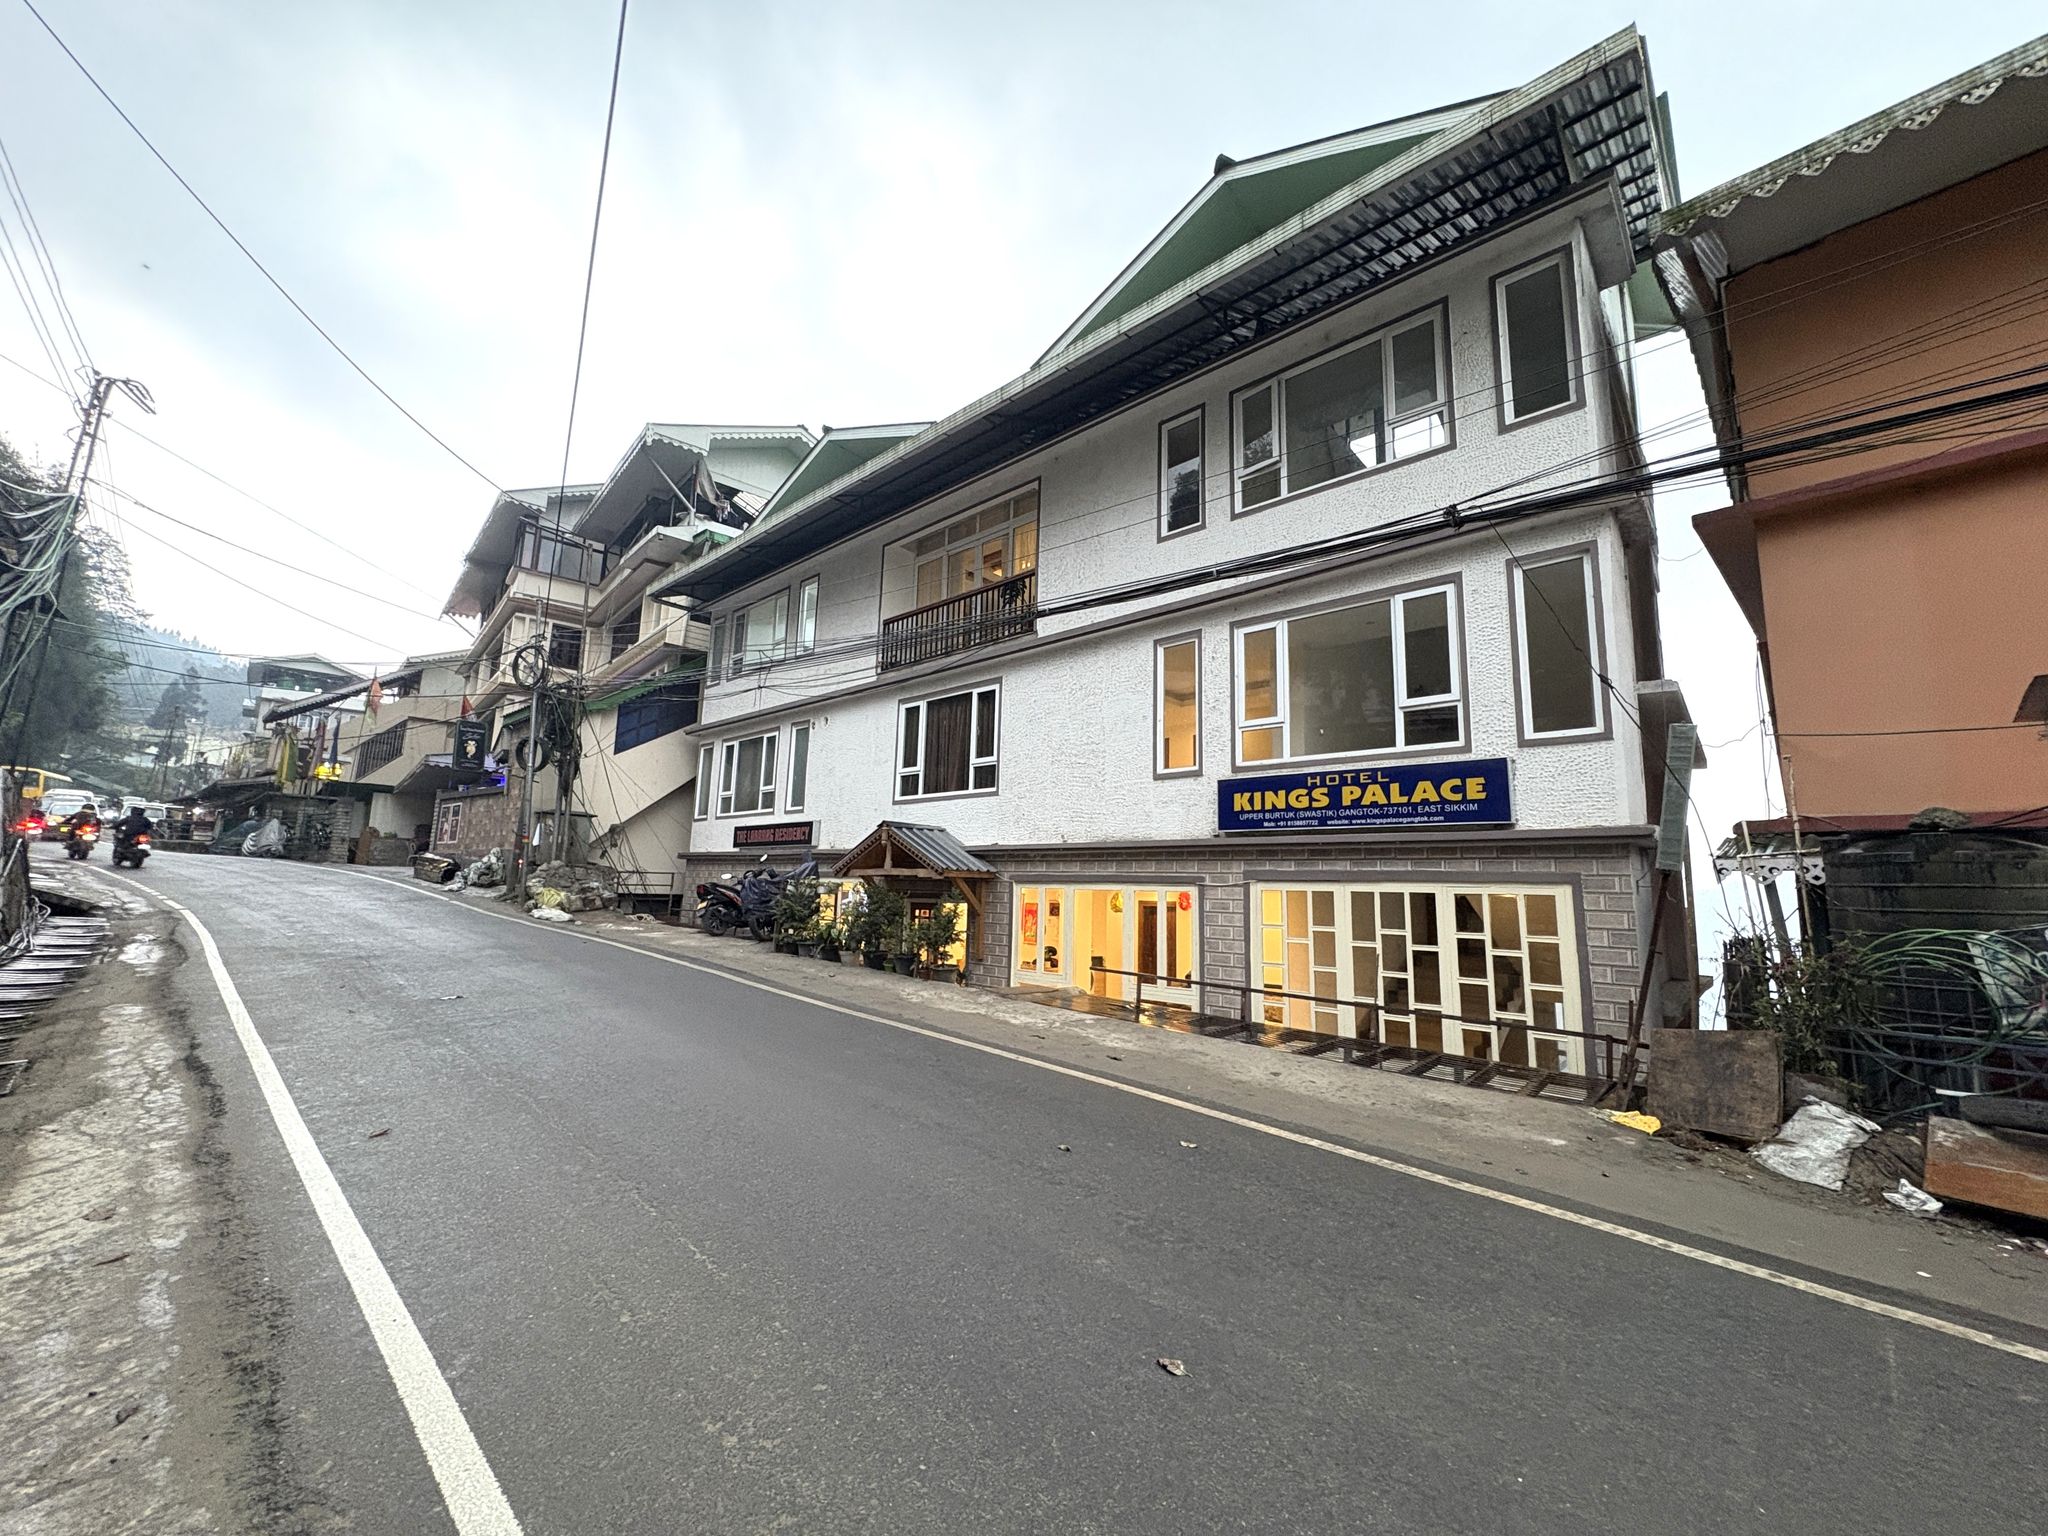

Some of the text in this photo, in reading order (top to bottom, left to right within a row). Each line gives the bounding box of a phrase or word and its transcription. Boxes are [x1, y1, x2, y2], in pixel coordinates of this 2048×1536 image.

[1307, 771, 1390, 787] HOTEL
[1233, 777, 1488, 812] KINGS PALACE
[1239, 812, 1264, 821] UPPER
[1265, 811, 1295, 820] BURTUK
[1296, 810, 1338, 819] (SWASTIK)
[1418, 804, 1442, 814] EAST
[1444, 803, 1478, 812] SIKKIM
